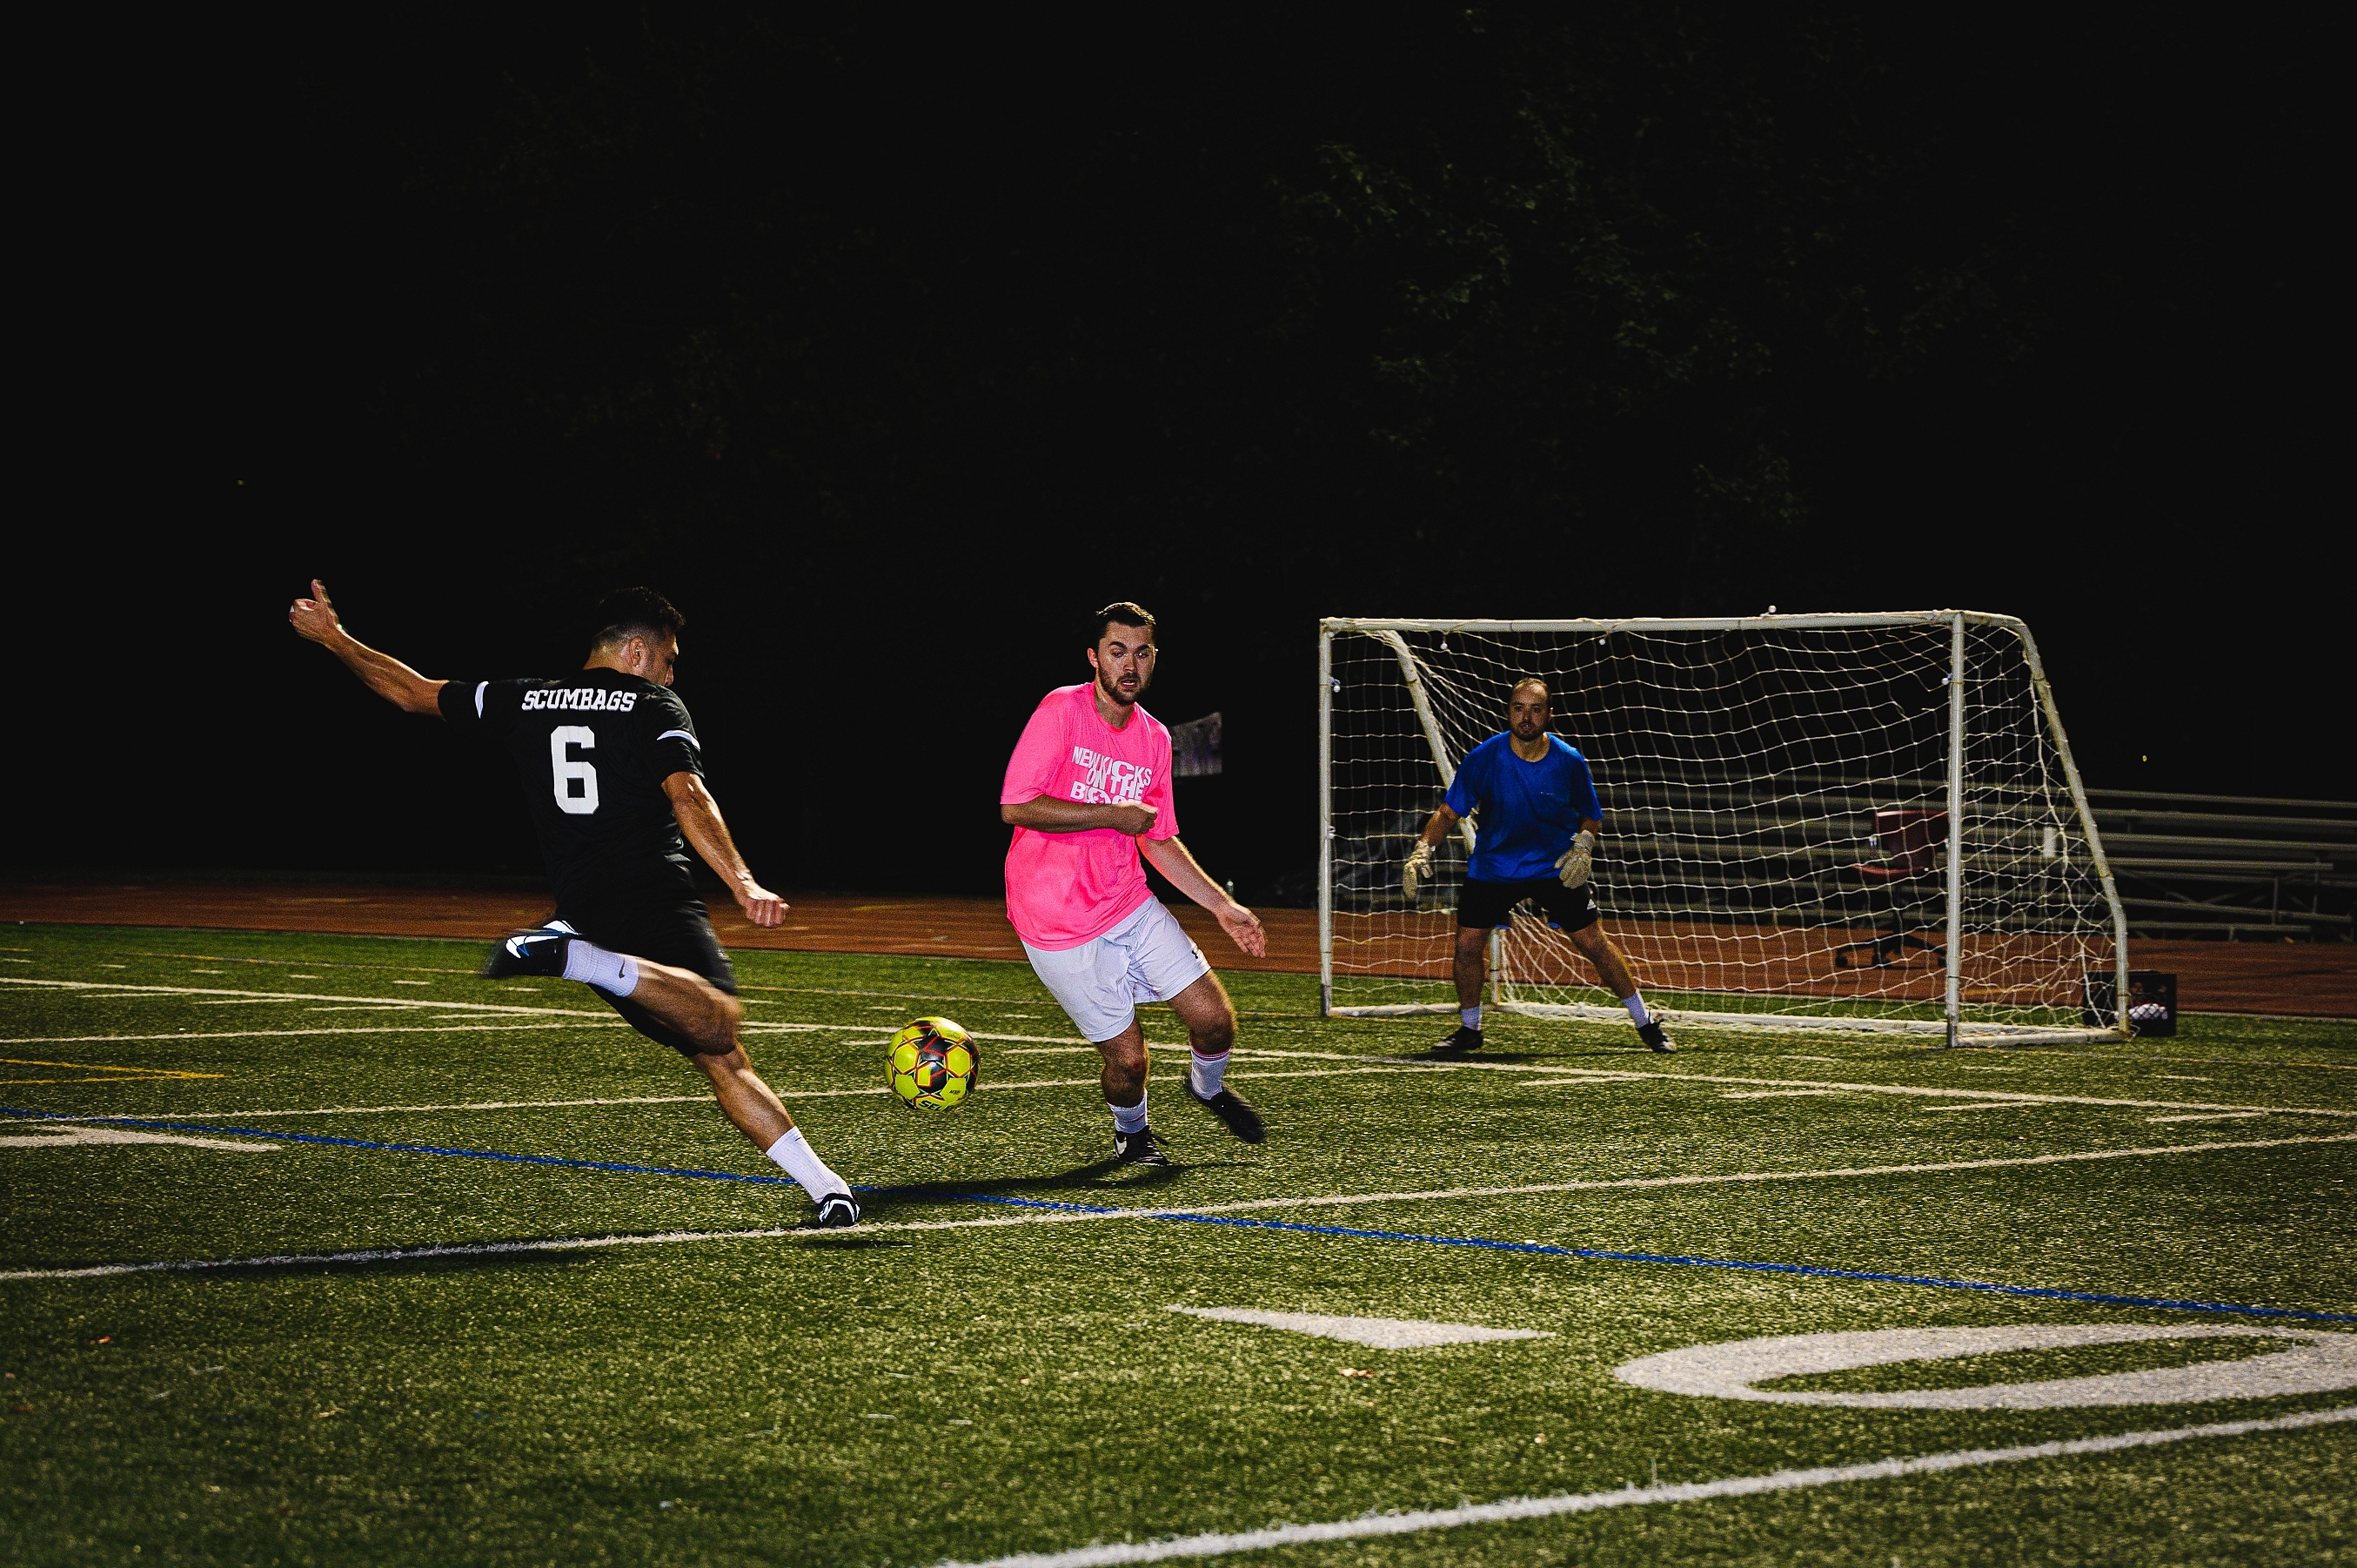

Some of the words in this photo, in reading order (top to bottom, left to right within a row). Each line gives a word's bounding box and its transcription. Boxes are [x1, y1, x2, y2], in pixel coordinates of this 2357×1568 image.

[521, 687, 638, 712] SCUMBAGS
[550, 725, 600, 815] 6
[1071, 746, 1101, 770] NEW
[1098, 754, 1153, 787] KICKS
[1085, 767, 1108, 790] ON
[1109, 774, 1145, 801] THE
